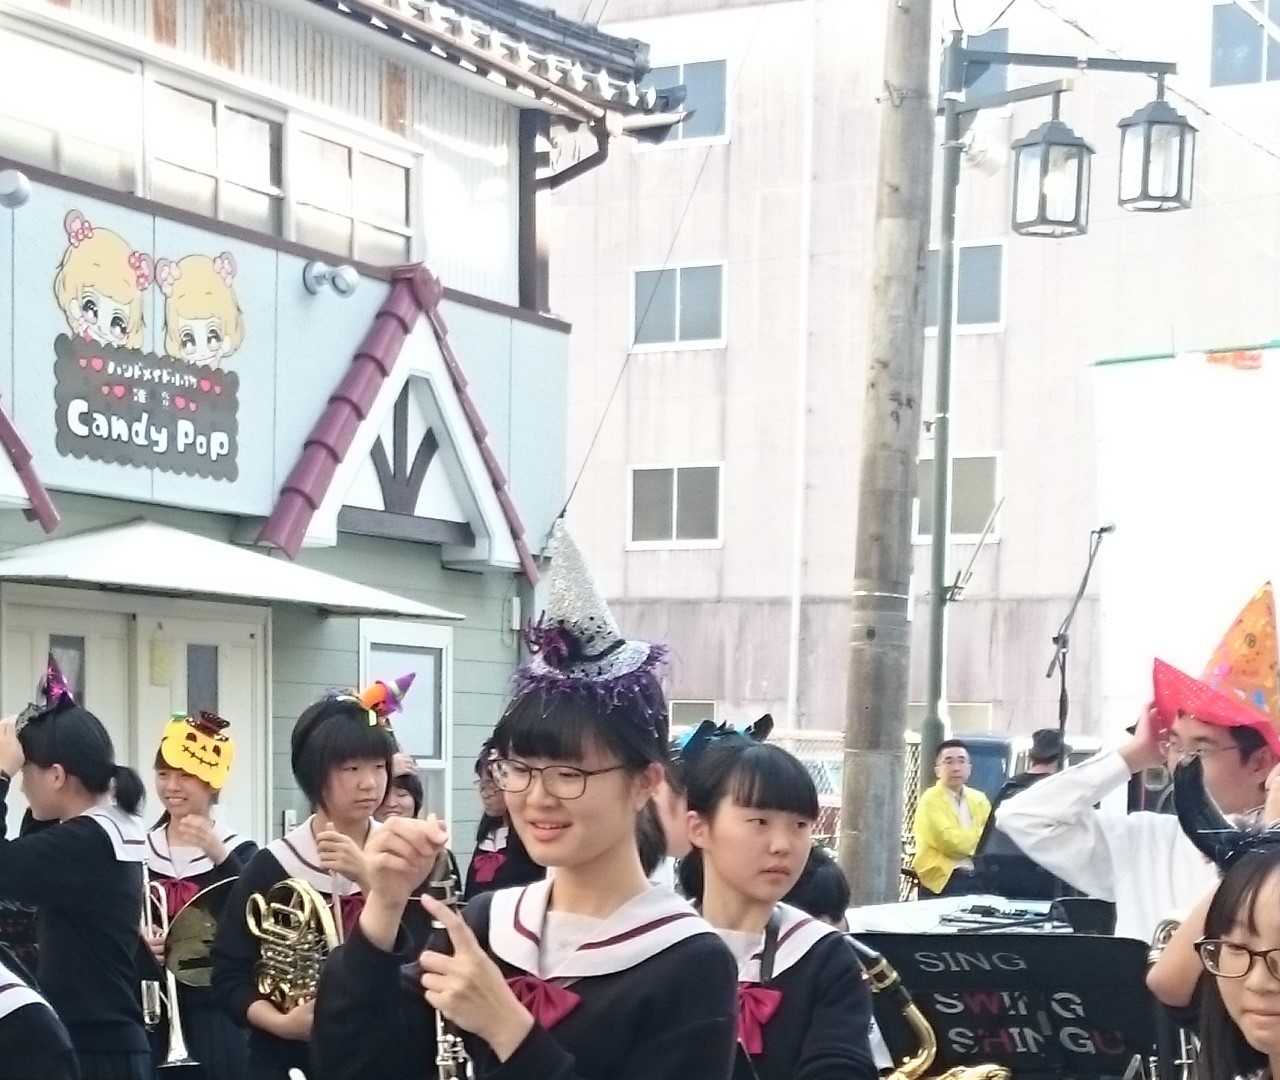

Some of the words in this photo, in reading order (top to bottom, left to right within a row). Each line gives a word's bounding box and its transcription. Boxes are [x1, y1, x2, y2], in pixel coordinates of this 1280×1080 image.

[67, 398, 168, 453] Candy
[177, 419, 230, 461] Pop
[914, 951, 1028, 972] SING
